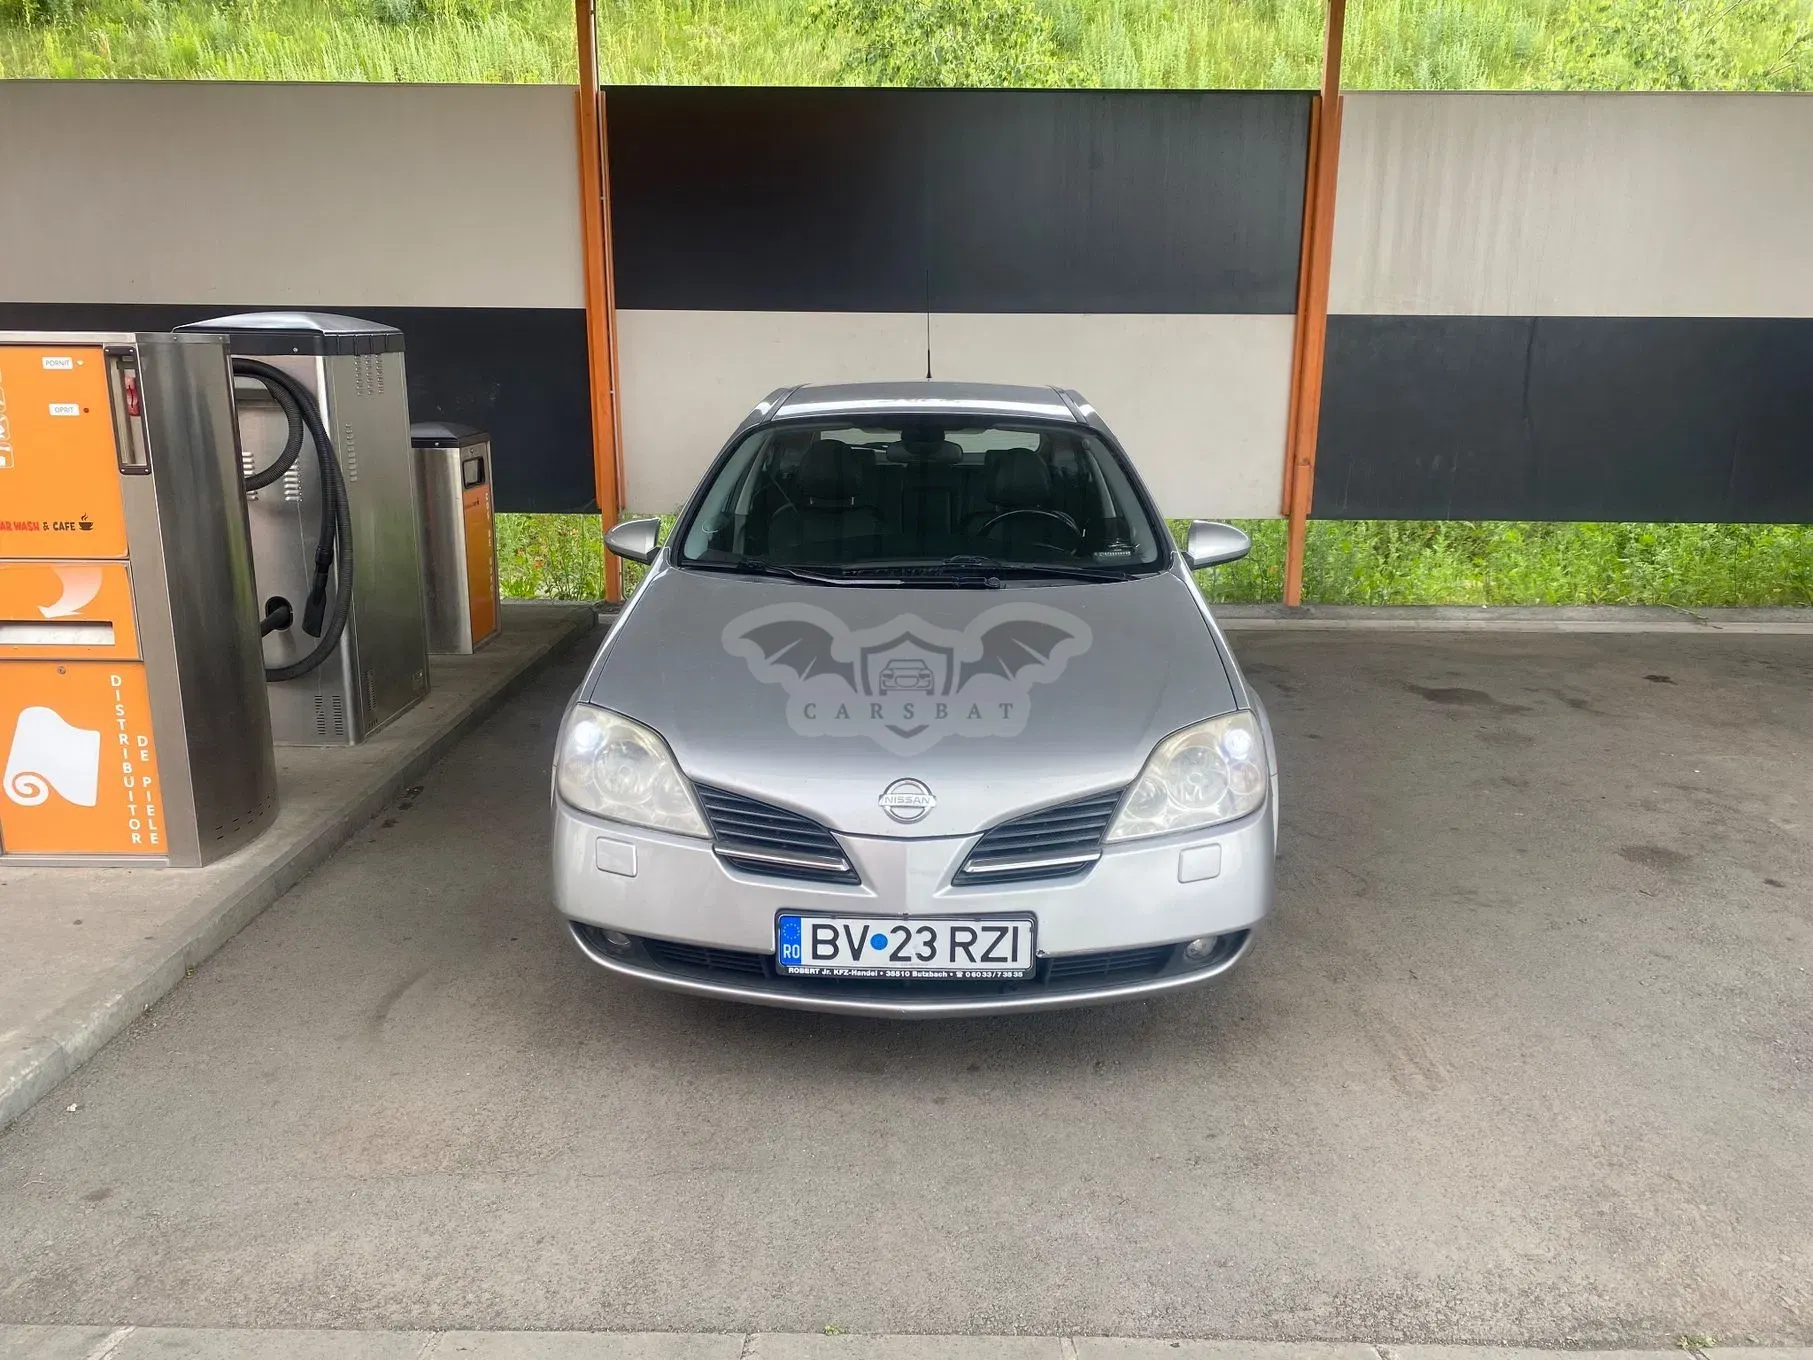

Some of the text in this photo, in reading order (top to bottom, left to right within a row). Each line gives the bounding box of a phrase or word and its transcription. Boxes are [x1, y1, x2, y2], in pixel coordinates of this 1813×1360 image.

[13, 521, 40, 532] WASH
[42, 521, 50, 532] &
[52, 521, 76, 531] CAFE
[110, 674, 142, 844] DISTRIBUITOR
[136, 735, 159, 844] DE PIELE
[884, 796, 930, 805] NISSAN
[811, 923, 1019, 963] BV 23 RZI
[783, 944, 800, 959] RO
[788, 967, 820, 975] ROBERT
[821, 968, 831, 976] Jr.
[833, 969, 878, 977] KFZ-Handel
